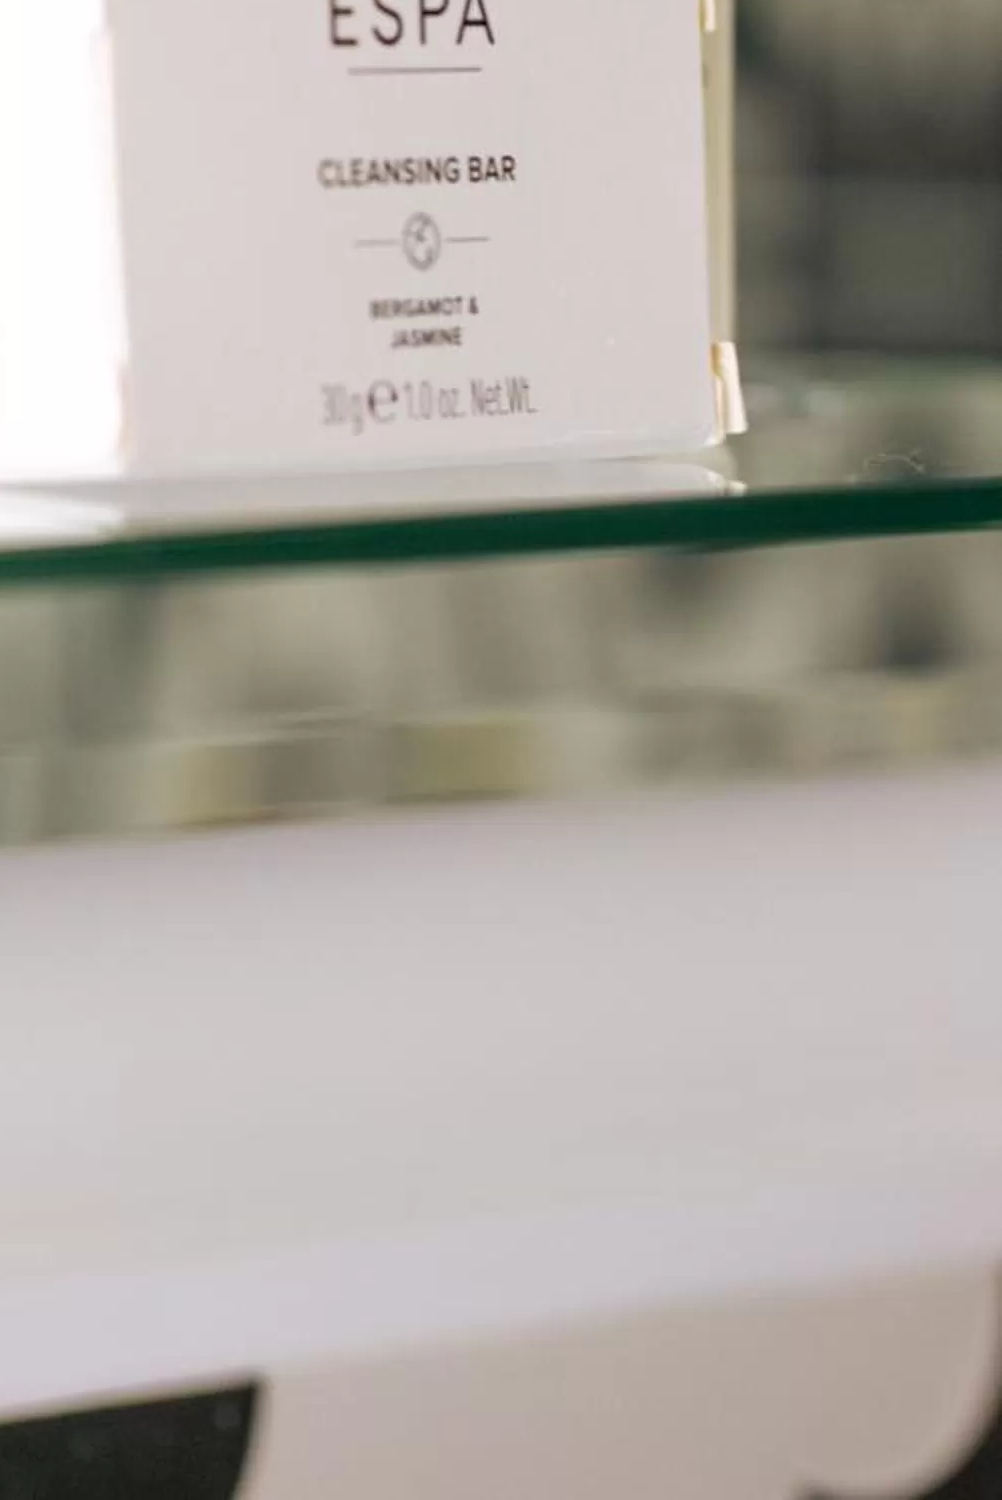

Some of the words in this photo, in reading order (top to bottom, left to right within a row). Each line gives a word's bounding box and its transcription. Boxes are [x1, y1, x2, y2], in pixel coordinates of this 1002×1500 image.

[317, 157, 461, 187] CLEANSING
[468, 155, 516, 182] BAR
[369, 296, 462, 318] BERGAMOT
[391, 325, 462, 348] JASMINE
